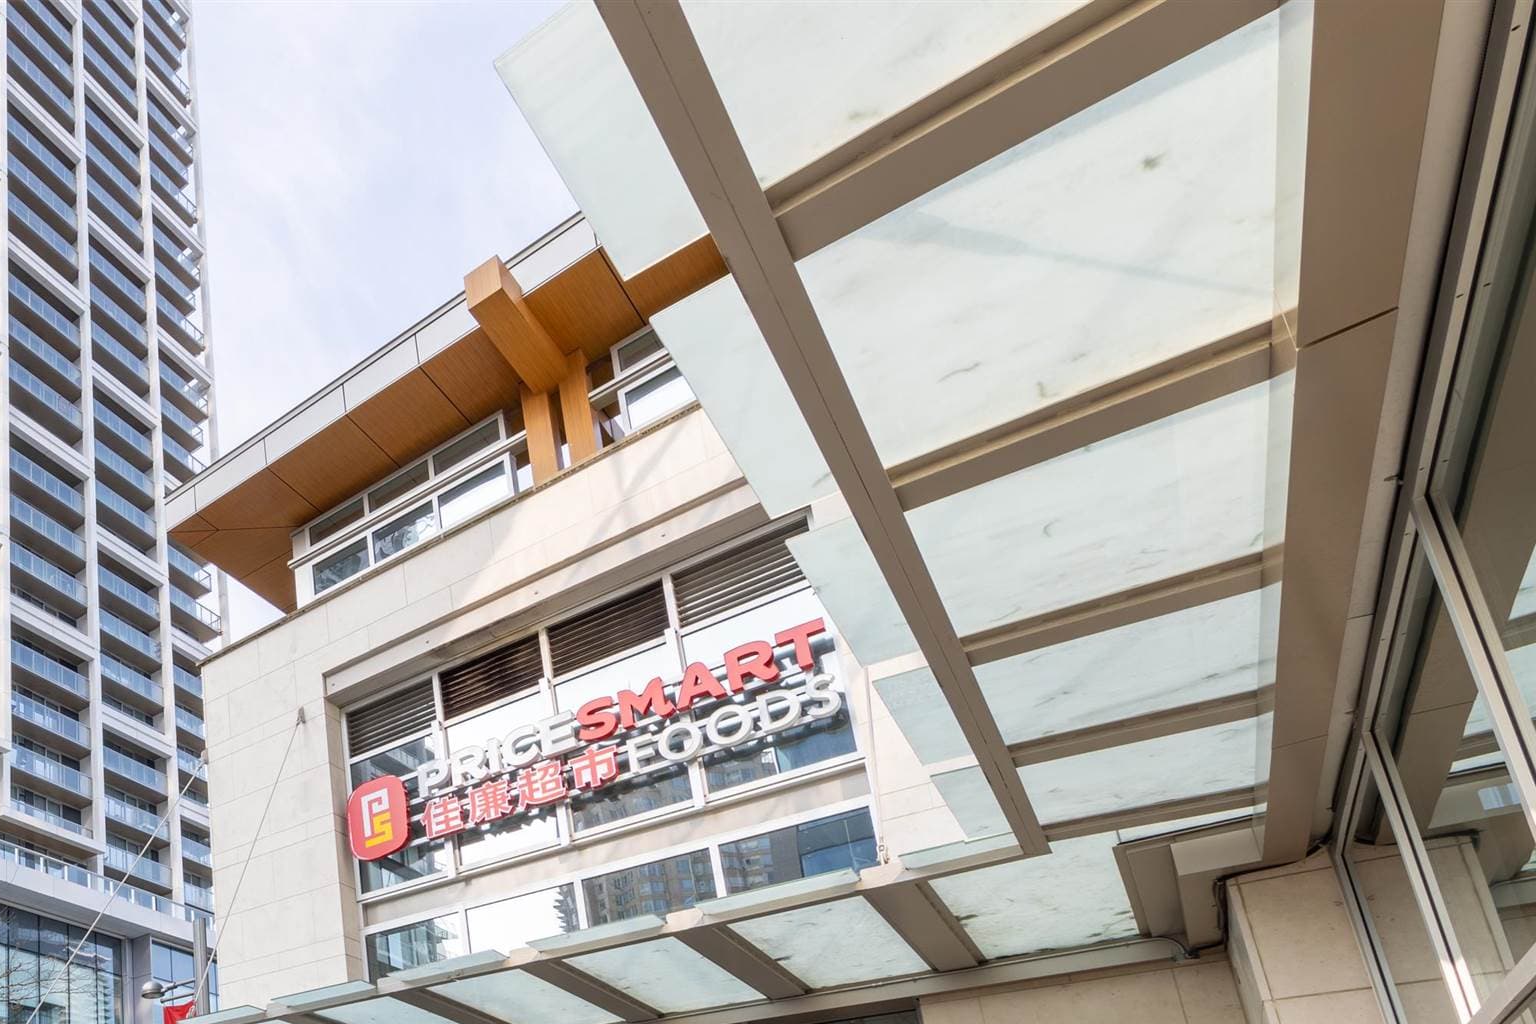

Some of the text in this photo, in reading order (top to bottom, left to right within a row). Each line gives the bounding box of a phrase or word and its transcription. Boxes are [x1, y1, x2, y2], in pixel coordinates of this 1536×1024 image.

[626, 672, 845, 775] FOODS
[420, 744, 620, 840] 佳廉超市
